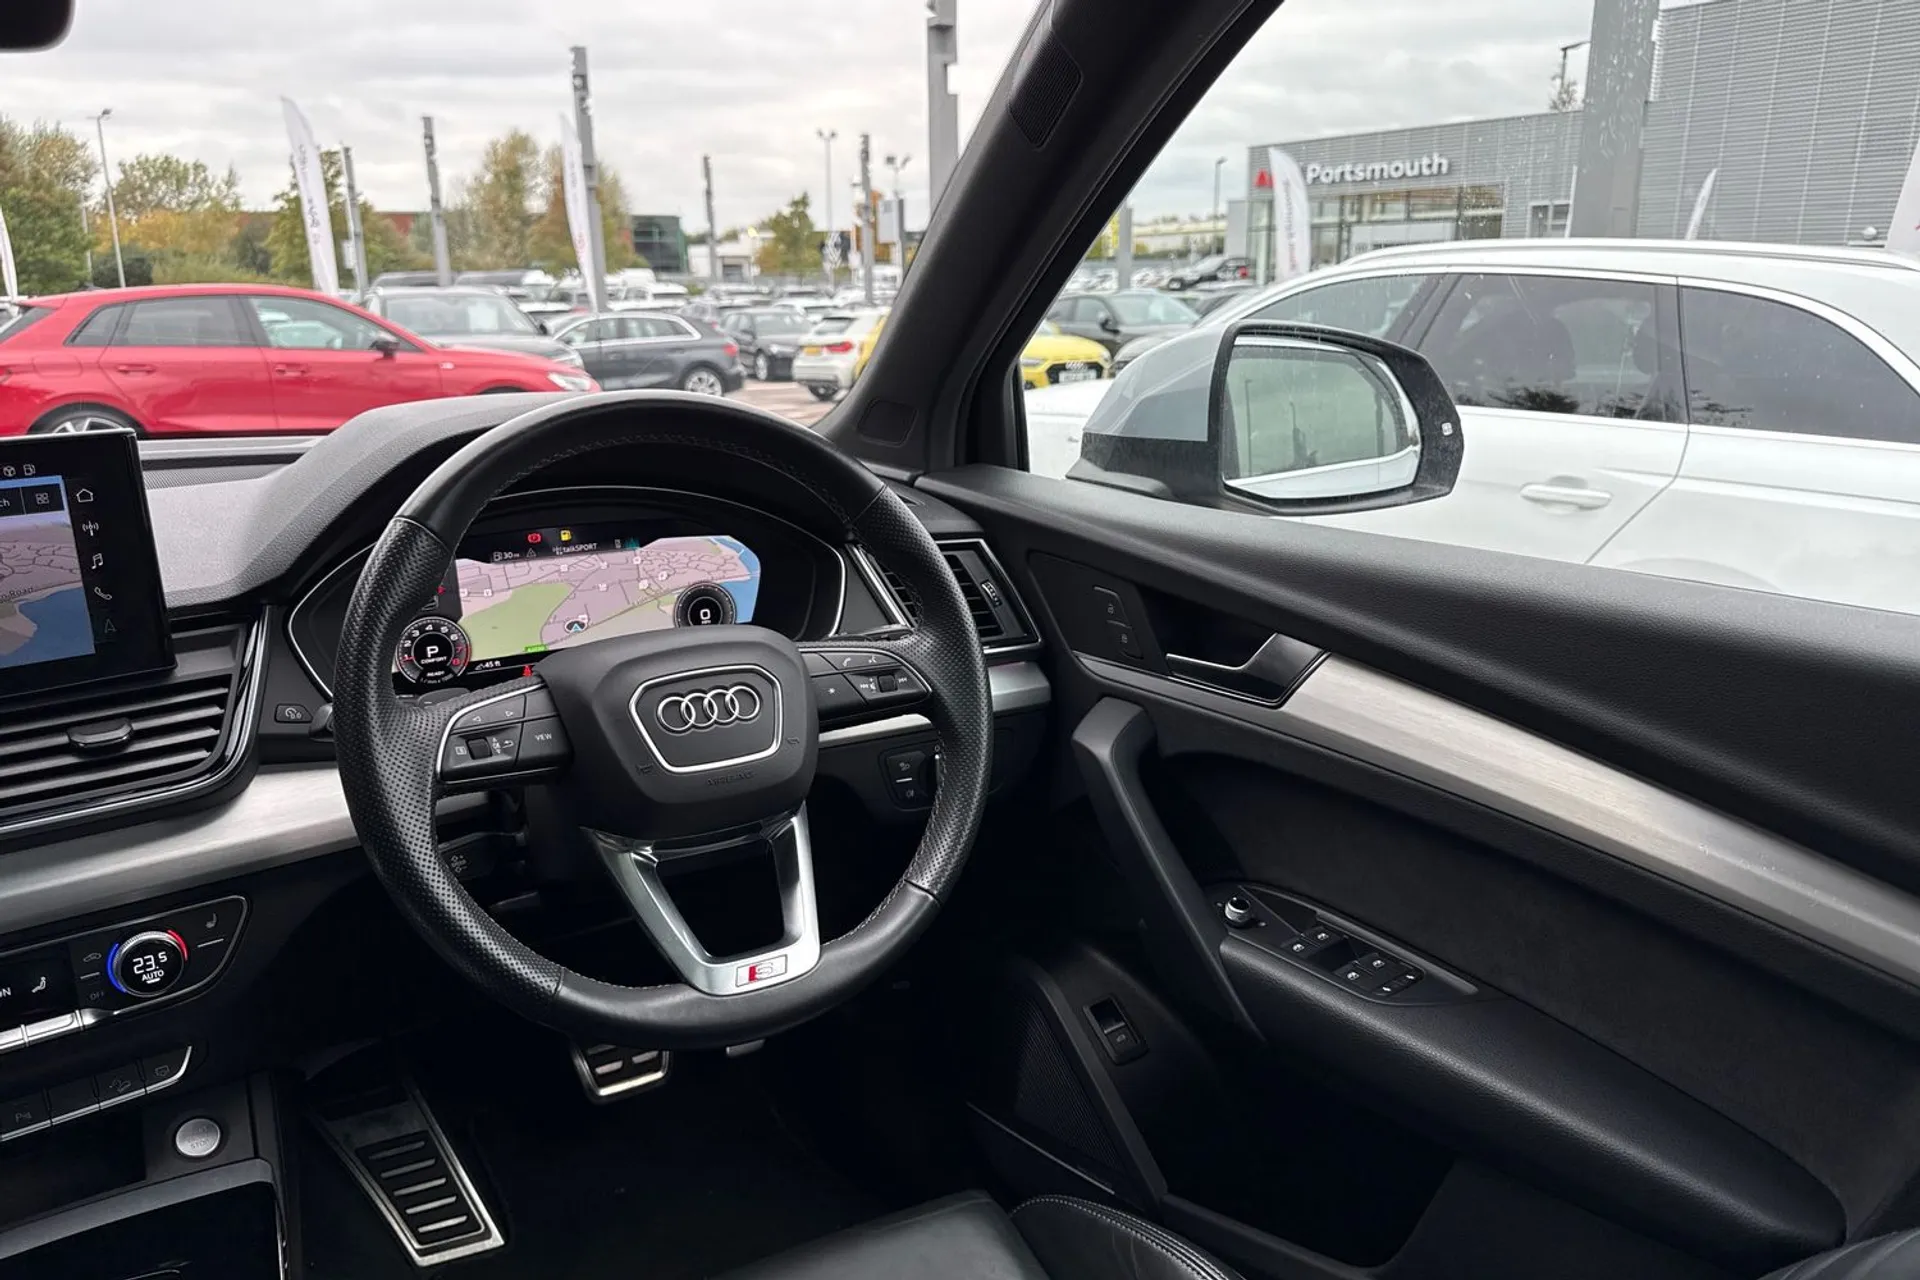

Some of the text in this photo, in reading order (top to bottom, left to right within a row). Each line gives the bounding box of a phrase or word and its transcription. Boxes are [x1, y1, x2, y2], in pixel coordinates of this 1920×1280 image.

[1305, 152, 1450, 185] Portsmouth
[503, 551, 513, 559] 30
[700, 609, 710, 620] 0
[411, 629, 420, 637] 3
[450, 633, 459, 641] 6
[426, 645, 439, 658] P
[420, 656, 447, 665] COMFORT
[534, 733, 552, 741] VIEW
[141, 969, 165, 982] AUTO
